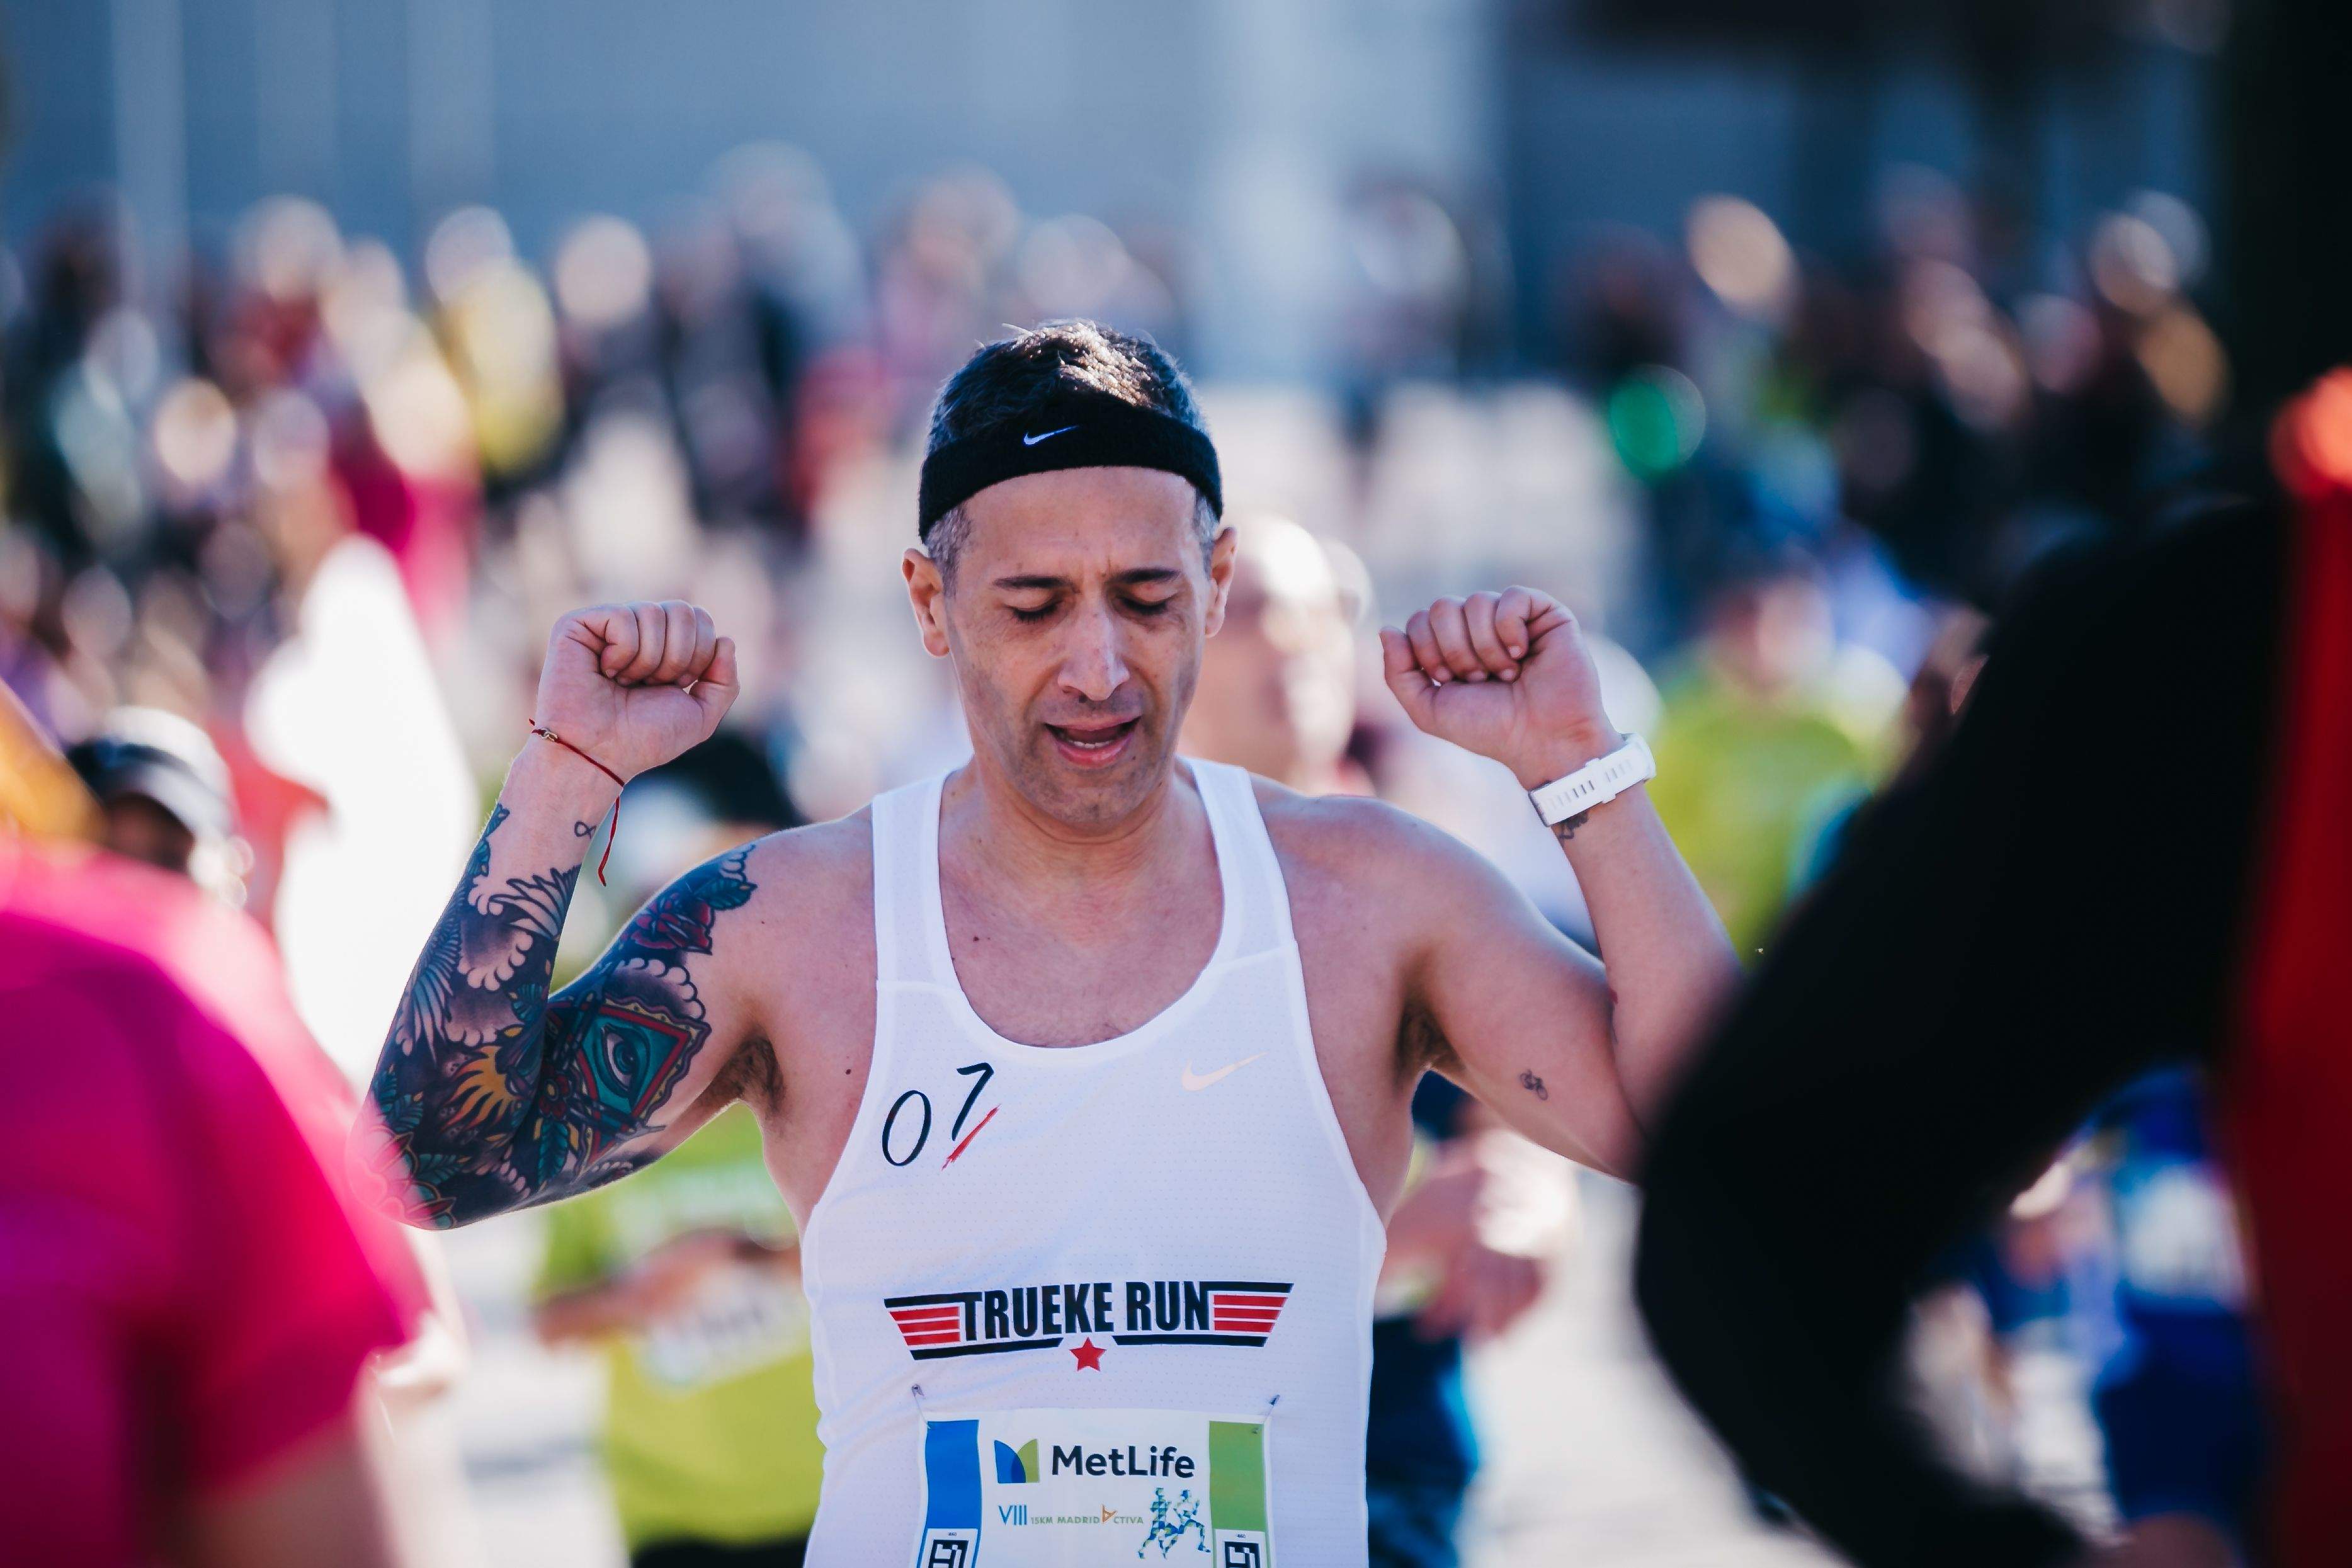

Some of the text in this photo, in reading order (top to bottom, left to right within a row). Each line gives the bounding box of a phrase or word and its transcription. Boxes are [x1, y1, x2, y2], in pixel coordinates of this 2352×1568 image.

[956, 1281, 1210, 1341] TRUEKE RUN
[1052, 1445, 1195, 1479] MetLife
[998, 1505, 1028, 1526] VIII
[1057, 1516, 1100, 1524] MADRID
